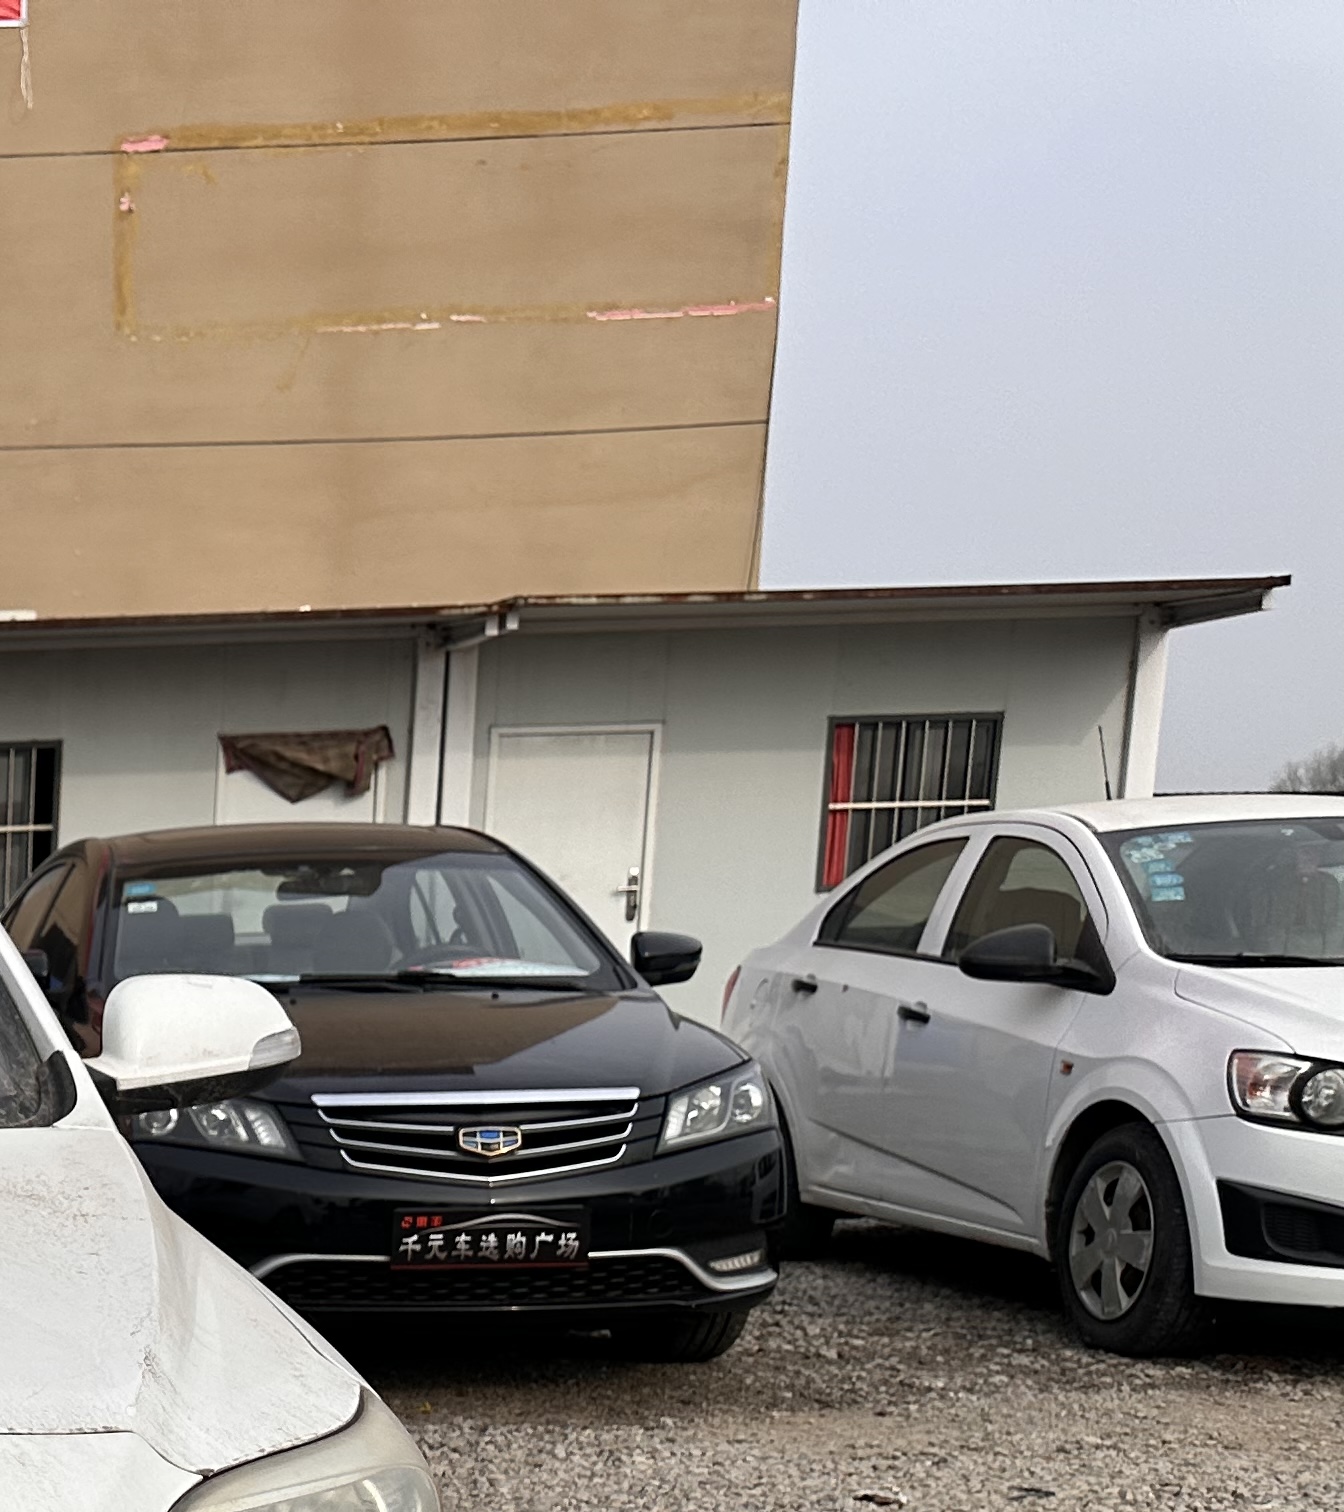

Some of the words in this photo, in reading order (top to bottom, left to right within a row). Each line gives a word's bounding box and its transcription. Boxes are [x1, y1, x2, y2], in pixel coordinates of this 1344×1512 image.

[398, 1231, 580, 1261] 千元车选购广场
